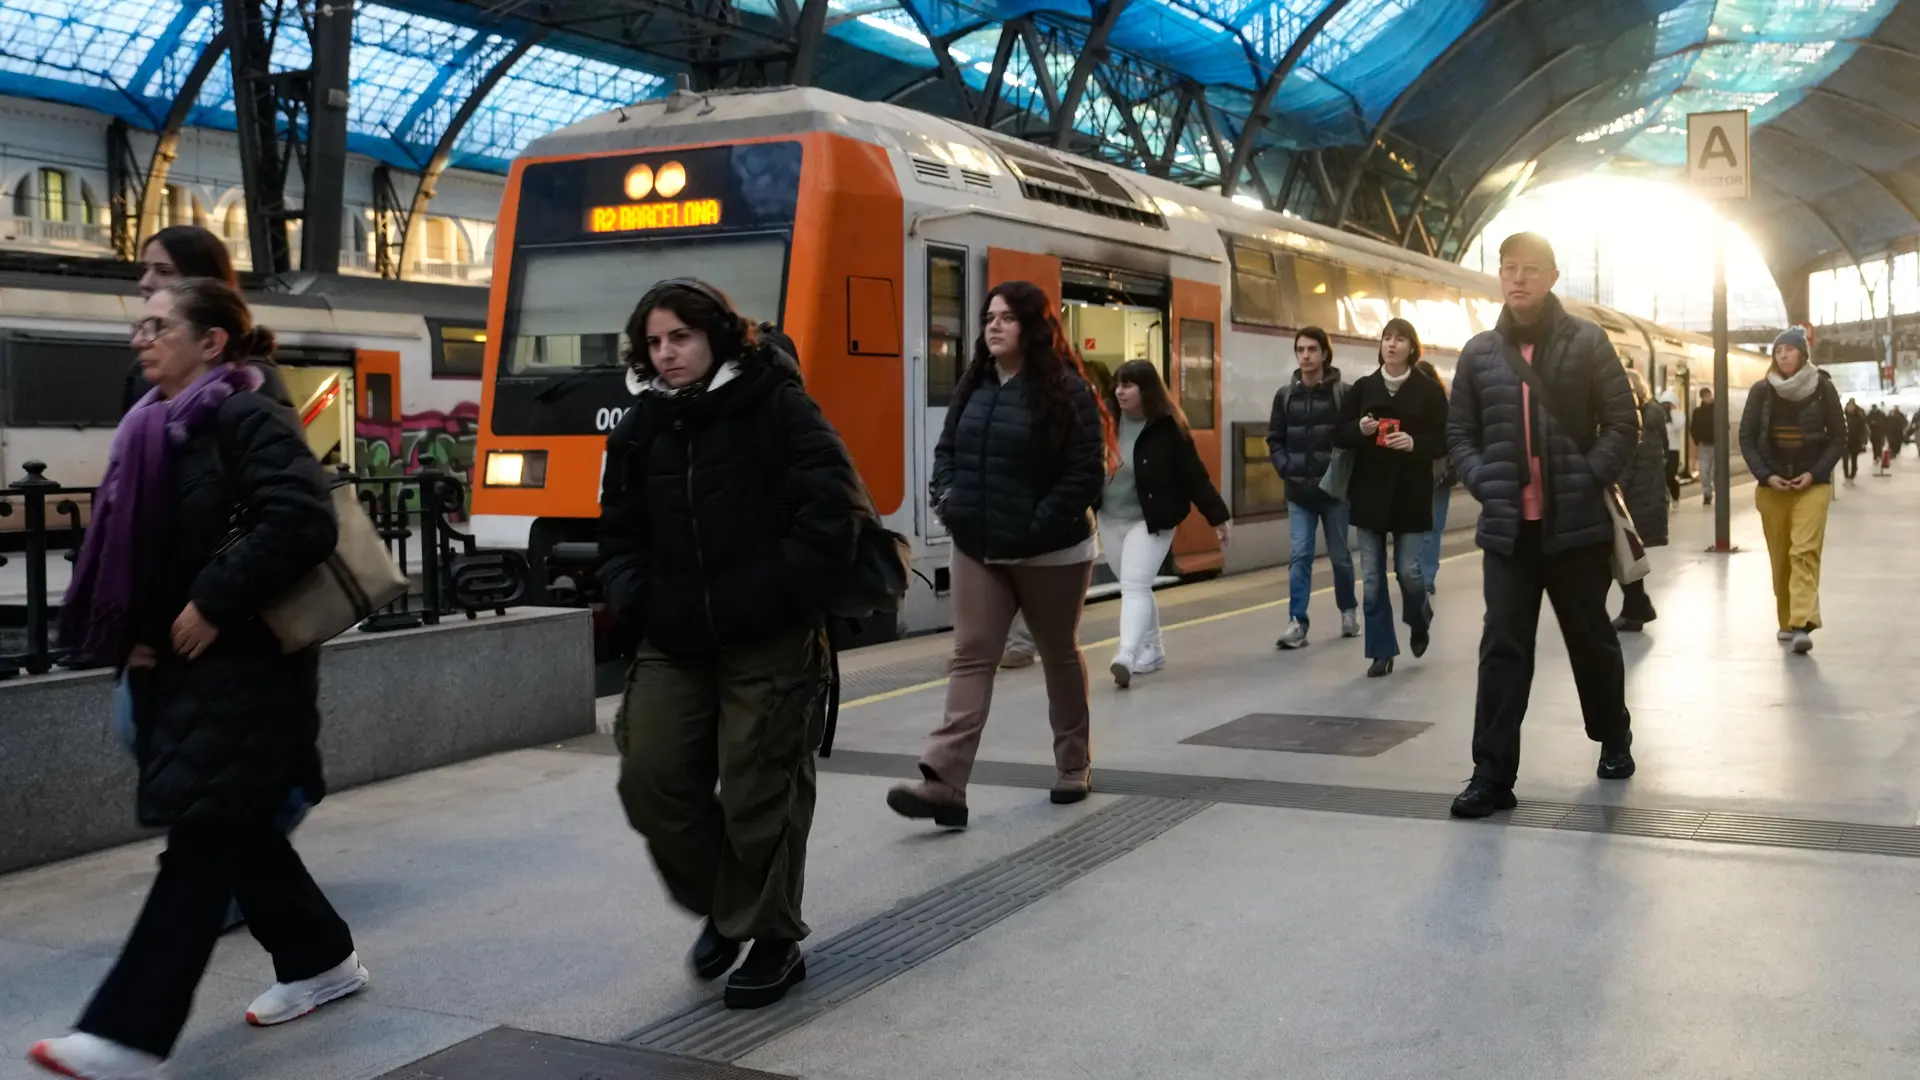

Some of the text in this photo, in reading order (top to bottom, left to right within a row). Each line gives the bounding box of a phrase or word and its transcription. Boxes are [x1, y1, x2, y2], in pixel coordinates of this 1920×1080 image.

[1698, 125, 1738, 169] A
[1697, 175, 1743, 188] ECTOR
[592, 199, 719, 232] R2 BARCELONA
[596, 407, 632, 431] 00
